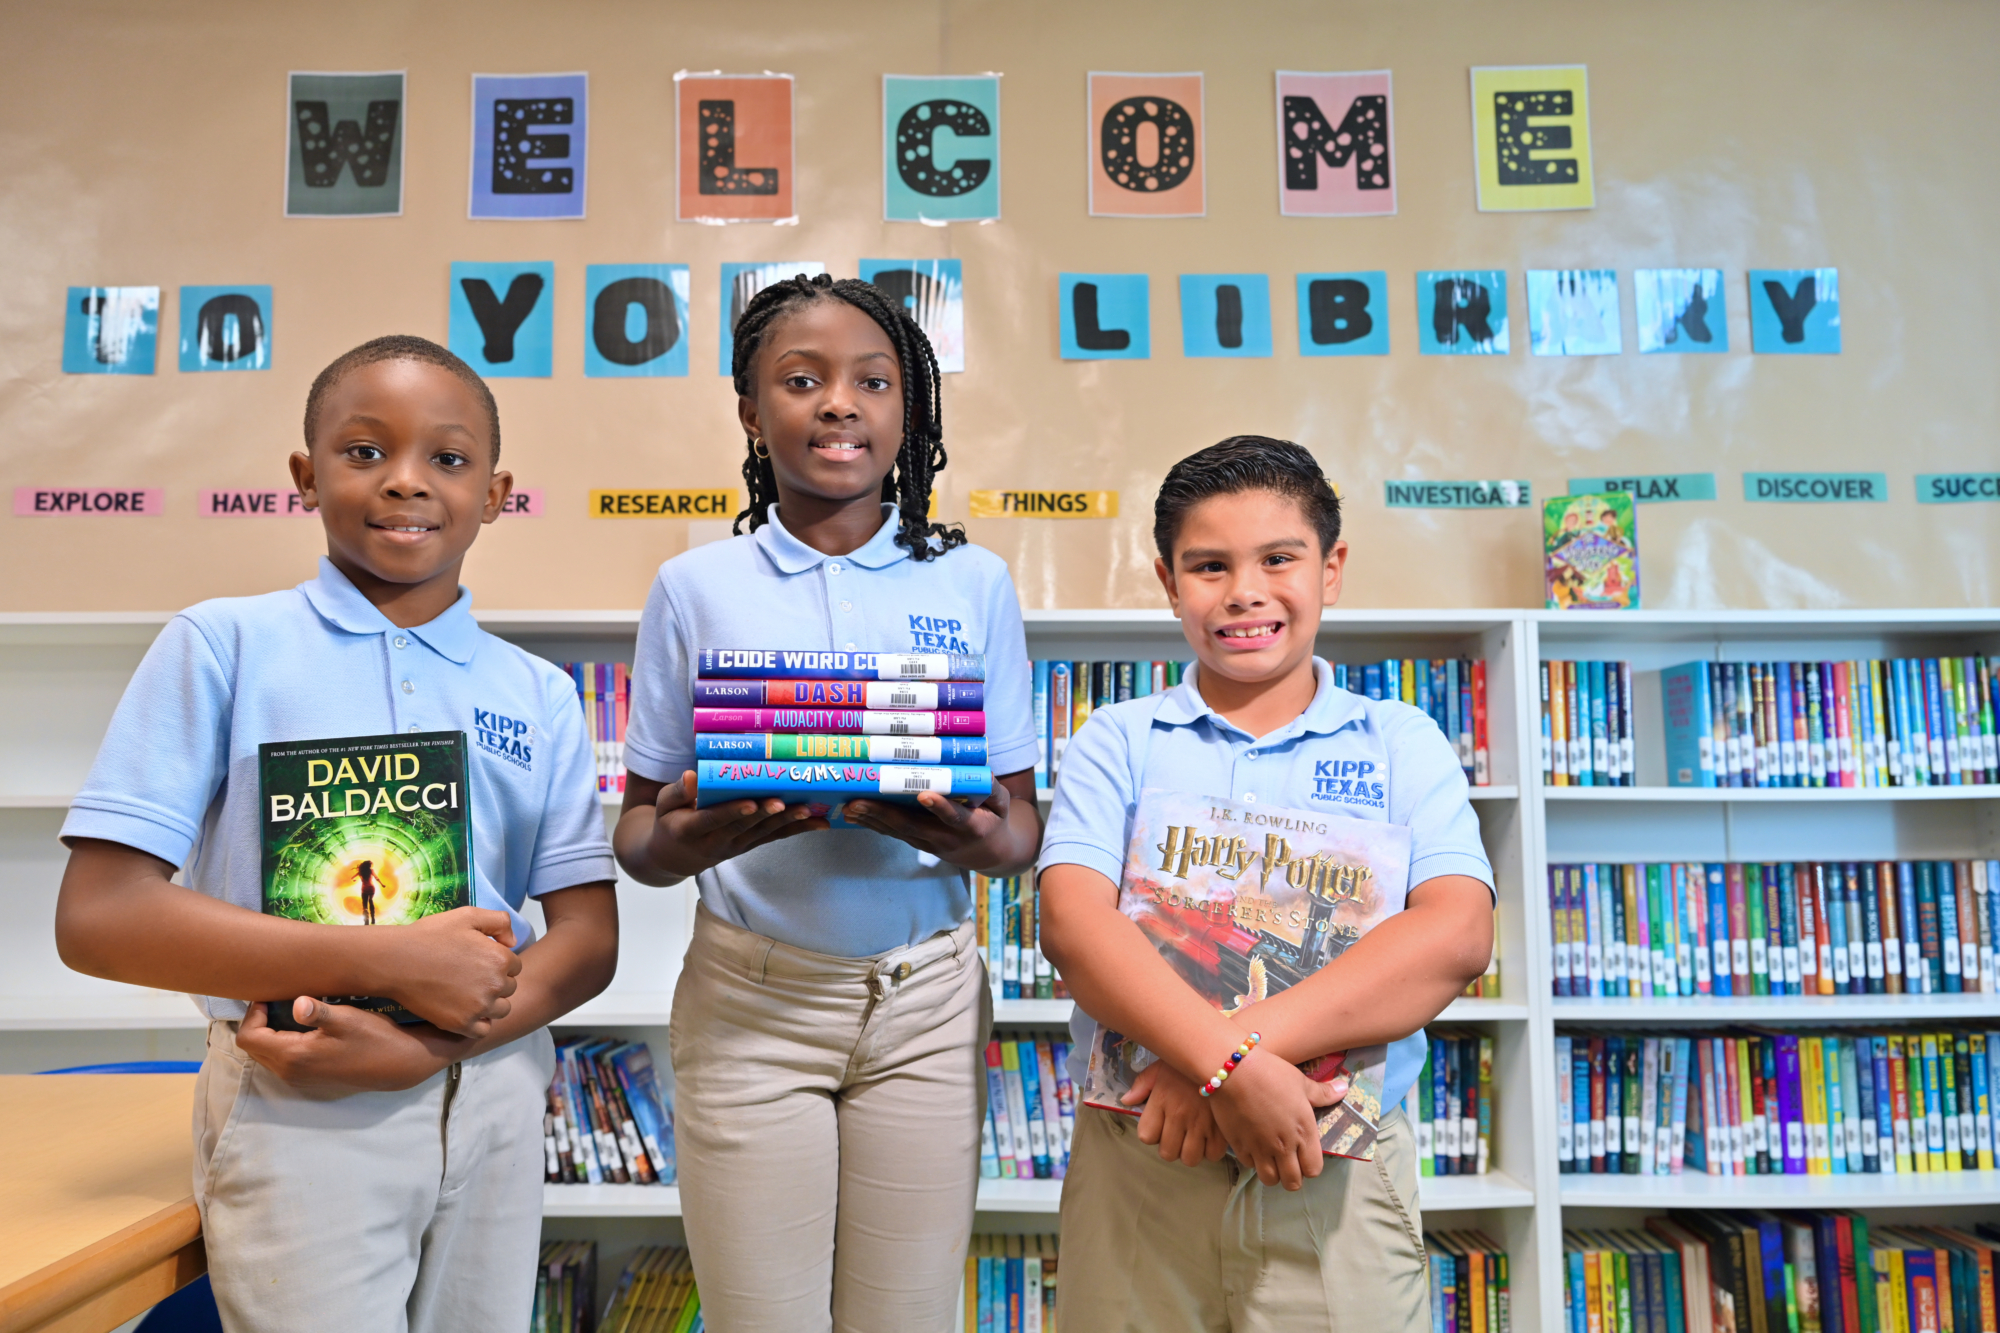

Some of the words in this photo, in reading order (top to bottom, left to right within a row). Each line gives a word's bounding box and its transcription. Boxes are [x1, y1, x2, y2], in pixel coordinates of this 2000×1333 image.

[295, 90, 1579, 197] WELCOME
[1605, 478, 1680, 500] RELAX
[1757, 478, 1874, 500] DISCOVER
[1931, 477, 2000, 499] SUCC
[34, 492, 145, 512] EXPLORE
[212, 493, 277, 513] HAVE
[600, 494, 727, 514] RESEARCH
[1001, 492, 1088, 512] THINGS
[908, 614, 962, 635] KIPP
[910, 631, 968, 655] TEXAS
[719, 650, 776, 668] CODE
[783, 652, 848, 670] WORD
[854, 653, 879, 670] CO
[705, 687, 749, 696] LARSON
[794, 681, 863, 704] DASH
[474, 707, 528, 738] KIPP
[712, 711, 743, 722] Larson
[774, 710, 834, 728] AUDACITY
[838, 711, 863, 728] JON
[474, 726, 532, 763] TEXAS
[476, 741, 502, 757] PUBLIC
[709, 741, 753, 750] LARSON
[307, 753, 420, 787] DAVID
[502, 753, 532, 772] SCHOOLS
[1314, 760, 1376, 778] KIPP
[719, 763, 787, 781] FAMILY
[790, 764, 842, 784] GAME
[843, 765, 881, 782] NIG
[1312, 777, 1384, 800] TEXAS
[270, 782, 459, 822] BALDACCI
[1311, 792, 1342, 802] PUBLIC
[1343, 796, 1385, 809] SCHOOLS
[1210, 807, 1237, 822] J.K.
[1243, 811, 1328, 835] ROWLING
[1156, 825, 1260, 881] Harry
[1260, 833, 1373, 905] Potter
[377, 1004, 396, 1013] with
[1980, 1280, 1995, 1332] JUSTIC
